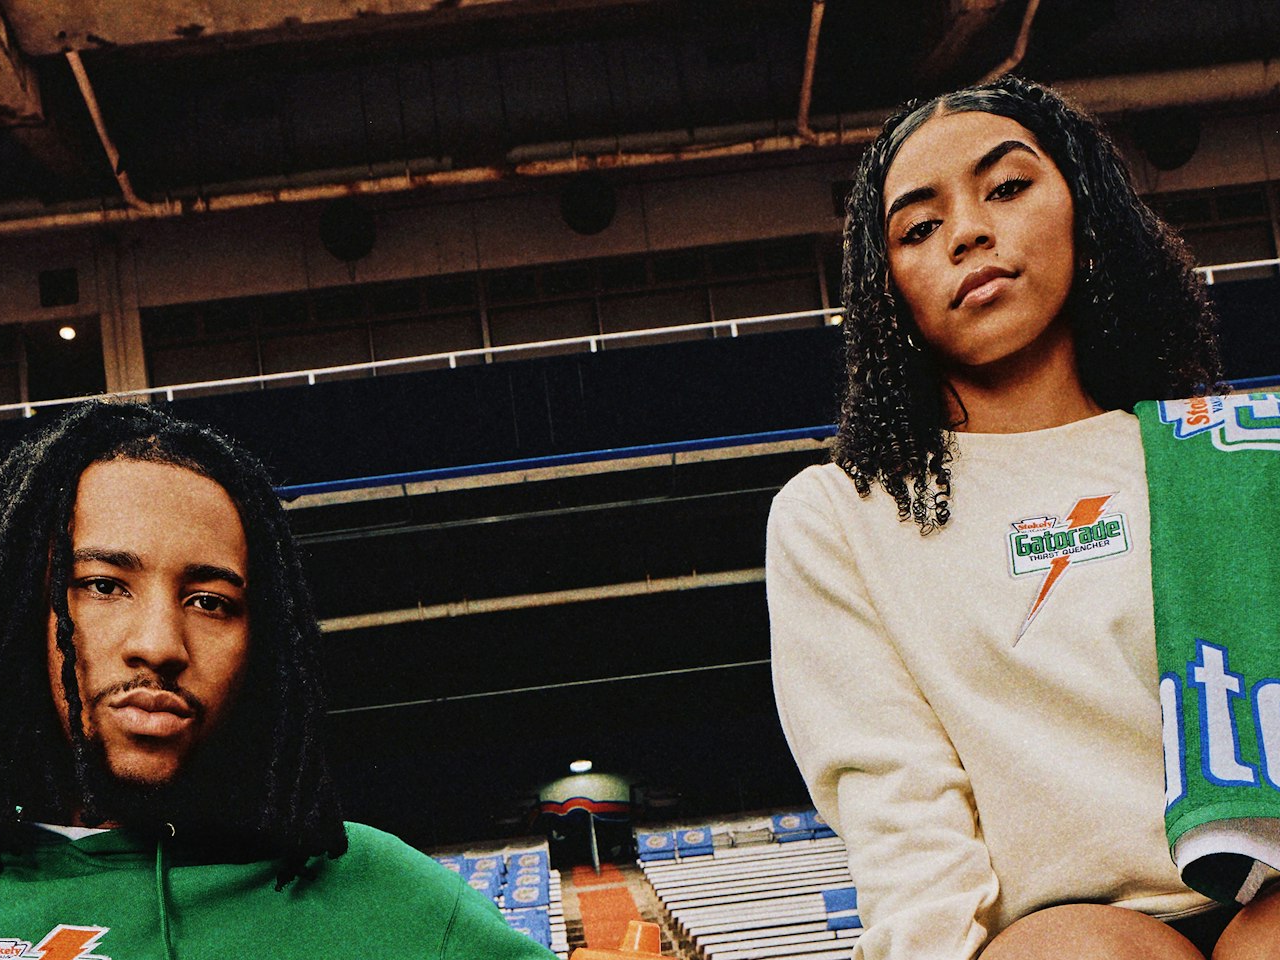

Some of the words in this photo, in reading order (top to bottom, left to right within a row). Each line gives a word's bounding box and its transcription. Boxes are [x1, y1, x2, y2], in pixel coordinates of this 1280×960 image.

[1015, 520, 1121, 557] Gatorade
[1029, 551, 1059, 562] THIRST
[1062, 540, 1110, 555] QUENCHER
